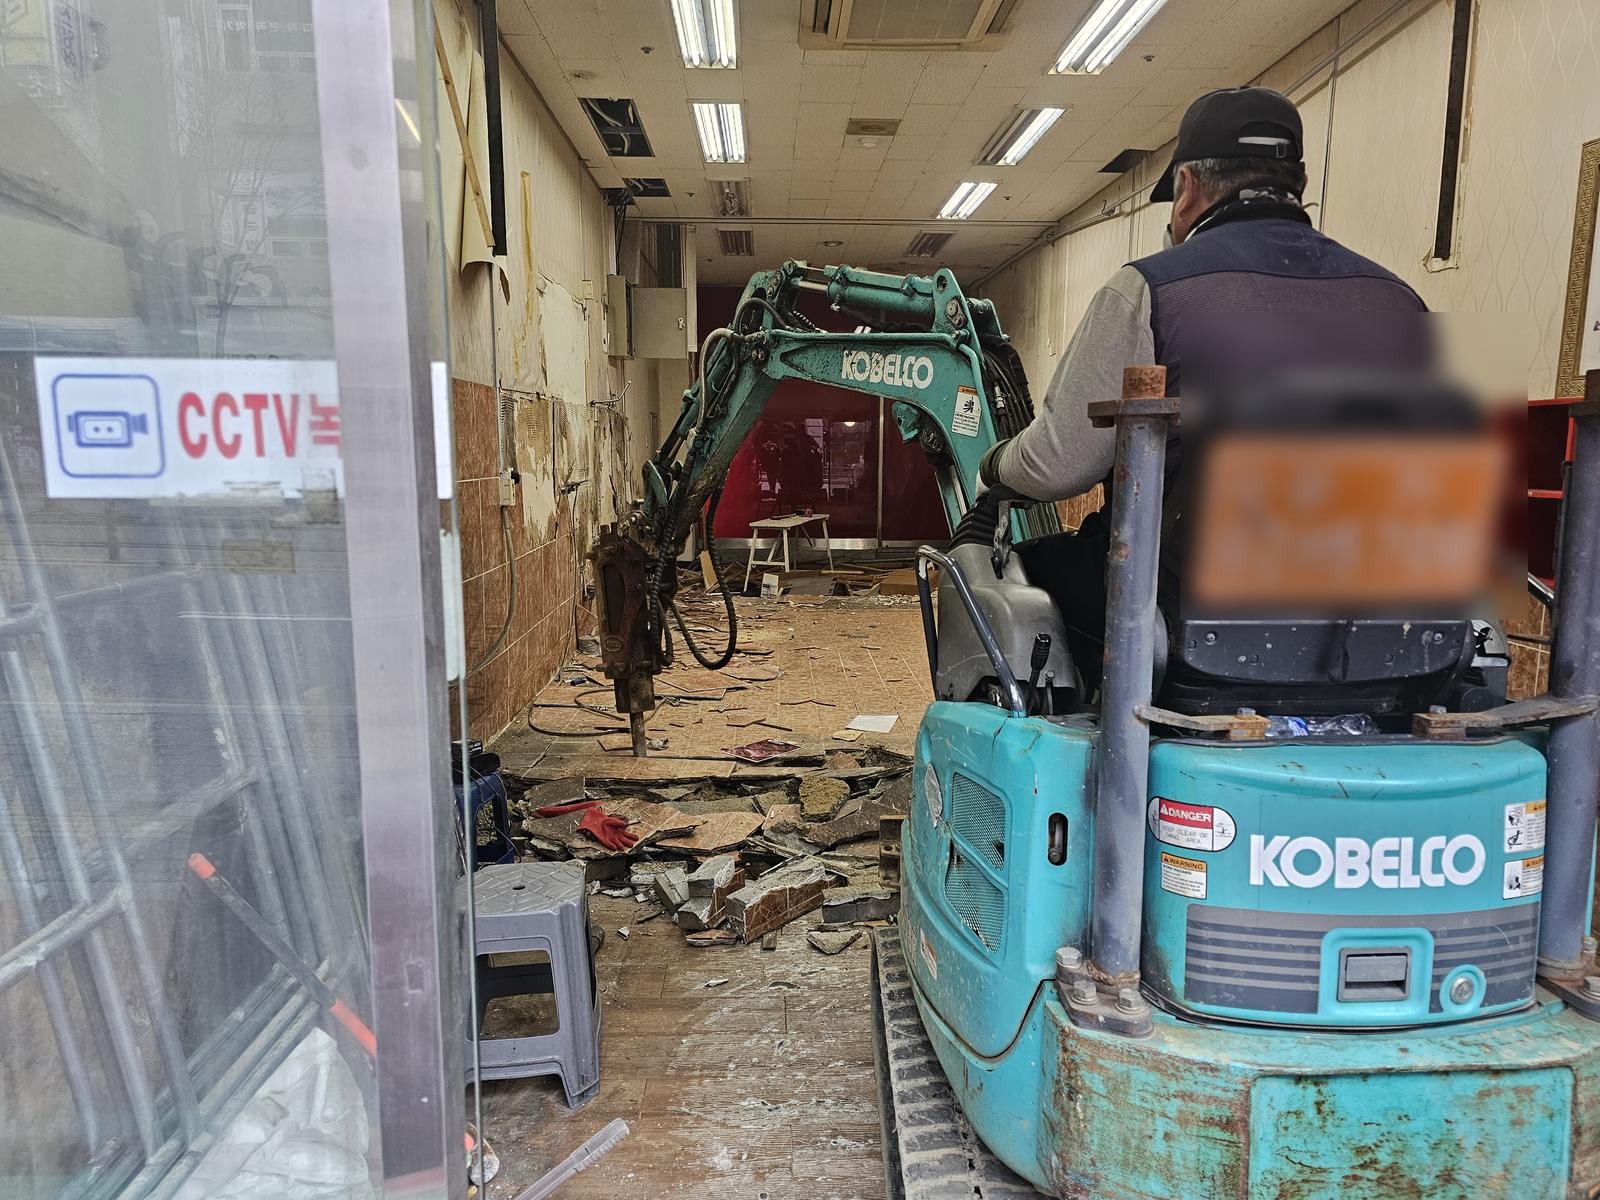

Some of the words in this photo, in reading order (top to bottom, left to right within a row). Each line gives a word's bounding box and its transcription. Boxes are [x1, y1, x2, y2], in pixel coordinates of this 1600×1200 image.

[841, 350, 934, 389] KOBELCO
[1168, 808, 1212, 822] DANGER
[1169, 857, 1203, 870] WARNING
[1250, 834, 1486, 889] KOBELCO
